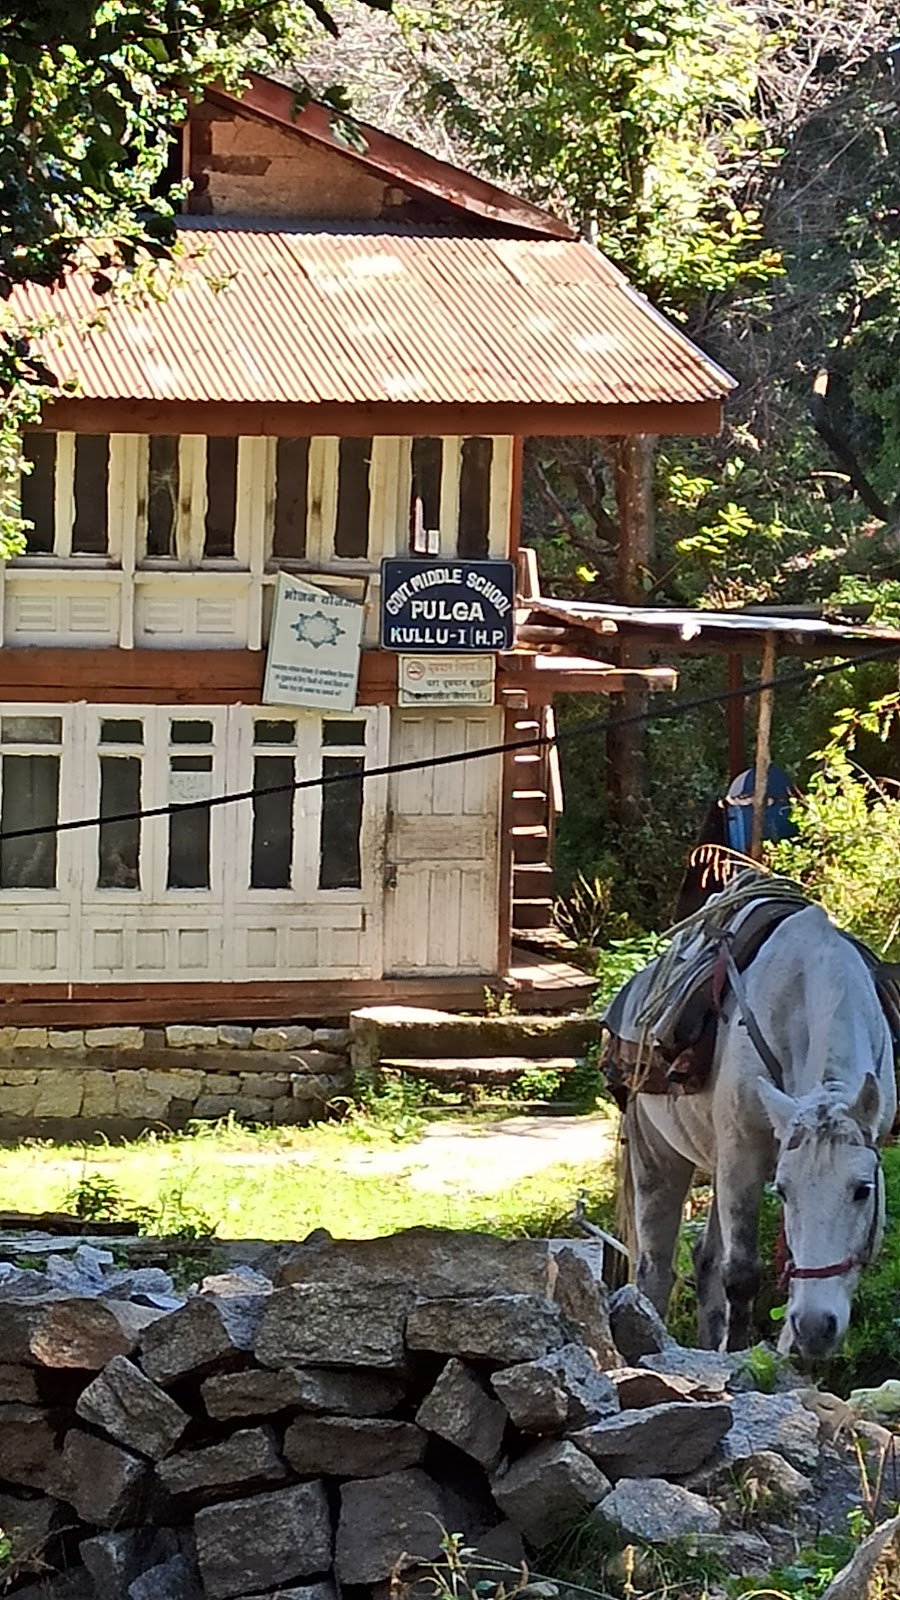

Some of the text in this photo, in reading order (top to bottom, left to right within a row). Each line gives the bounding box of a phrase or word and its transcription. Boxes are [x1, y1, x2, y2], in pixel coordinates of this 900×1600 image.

[409, 567, 463, 593] MIDDLE
[466, 571, 512, 617] SCHOOL
[410, 600, 486, 622] PULGA
[390, 626, 467, 644] KULLU-I
